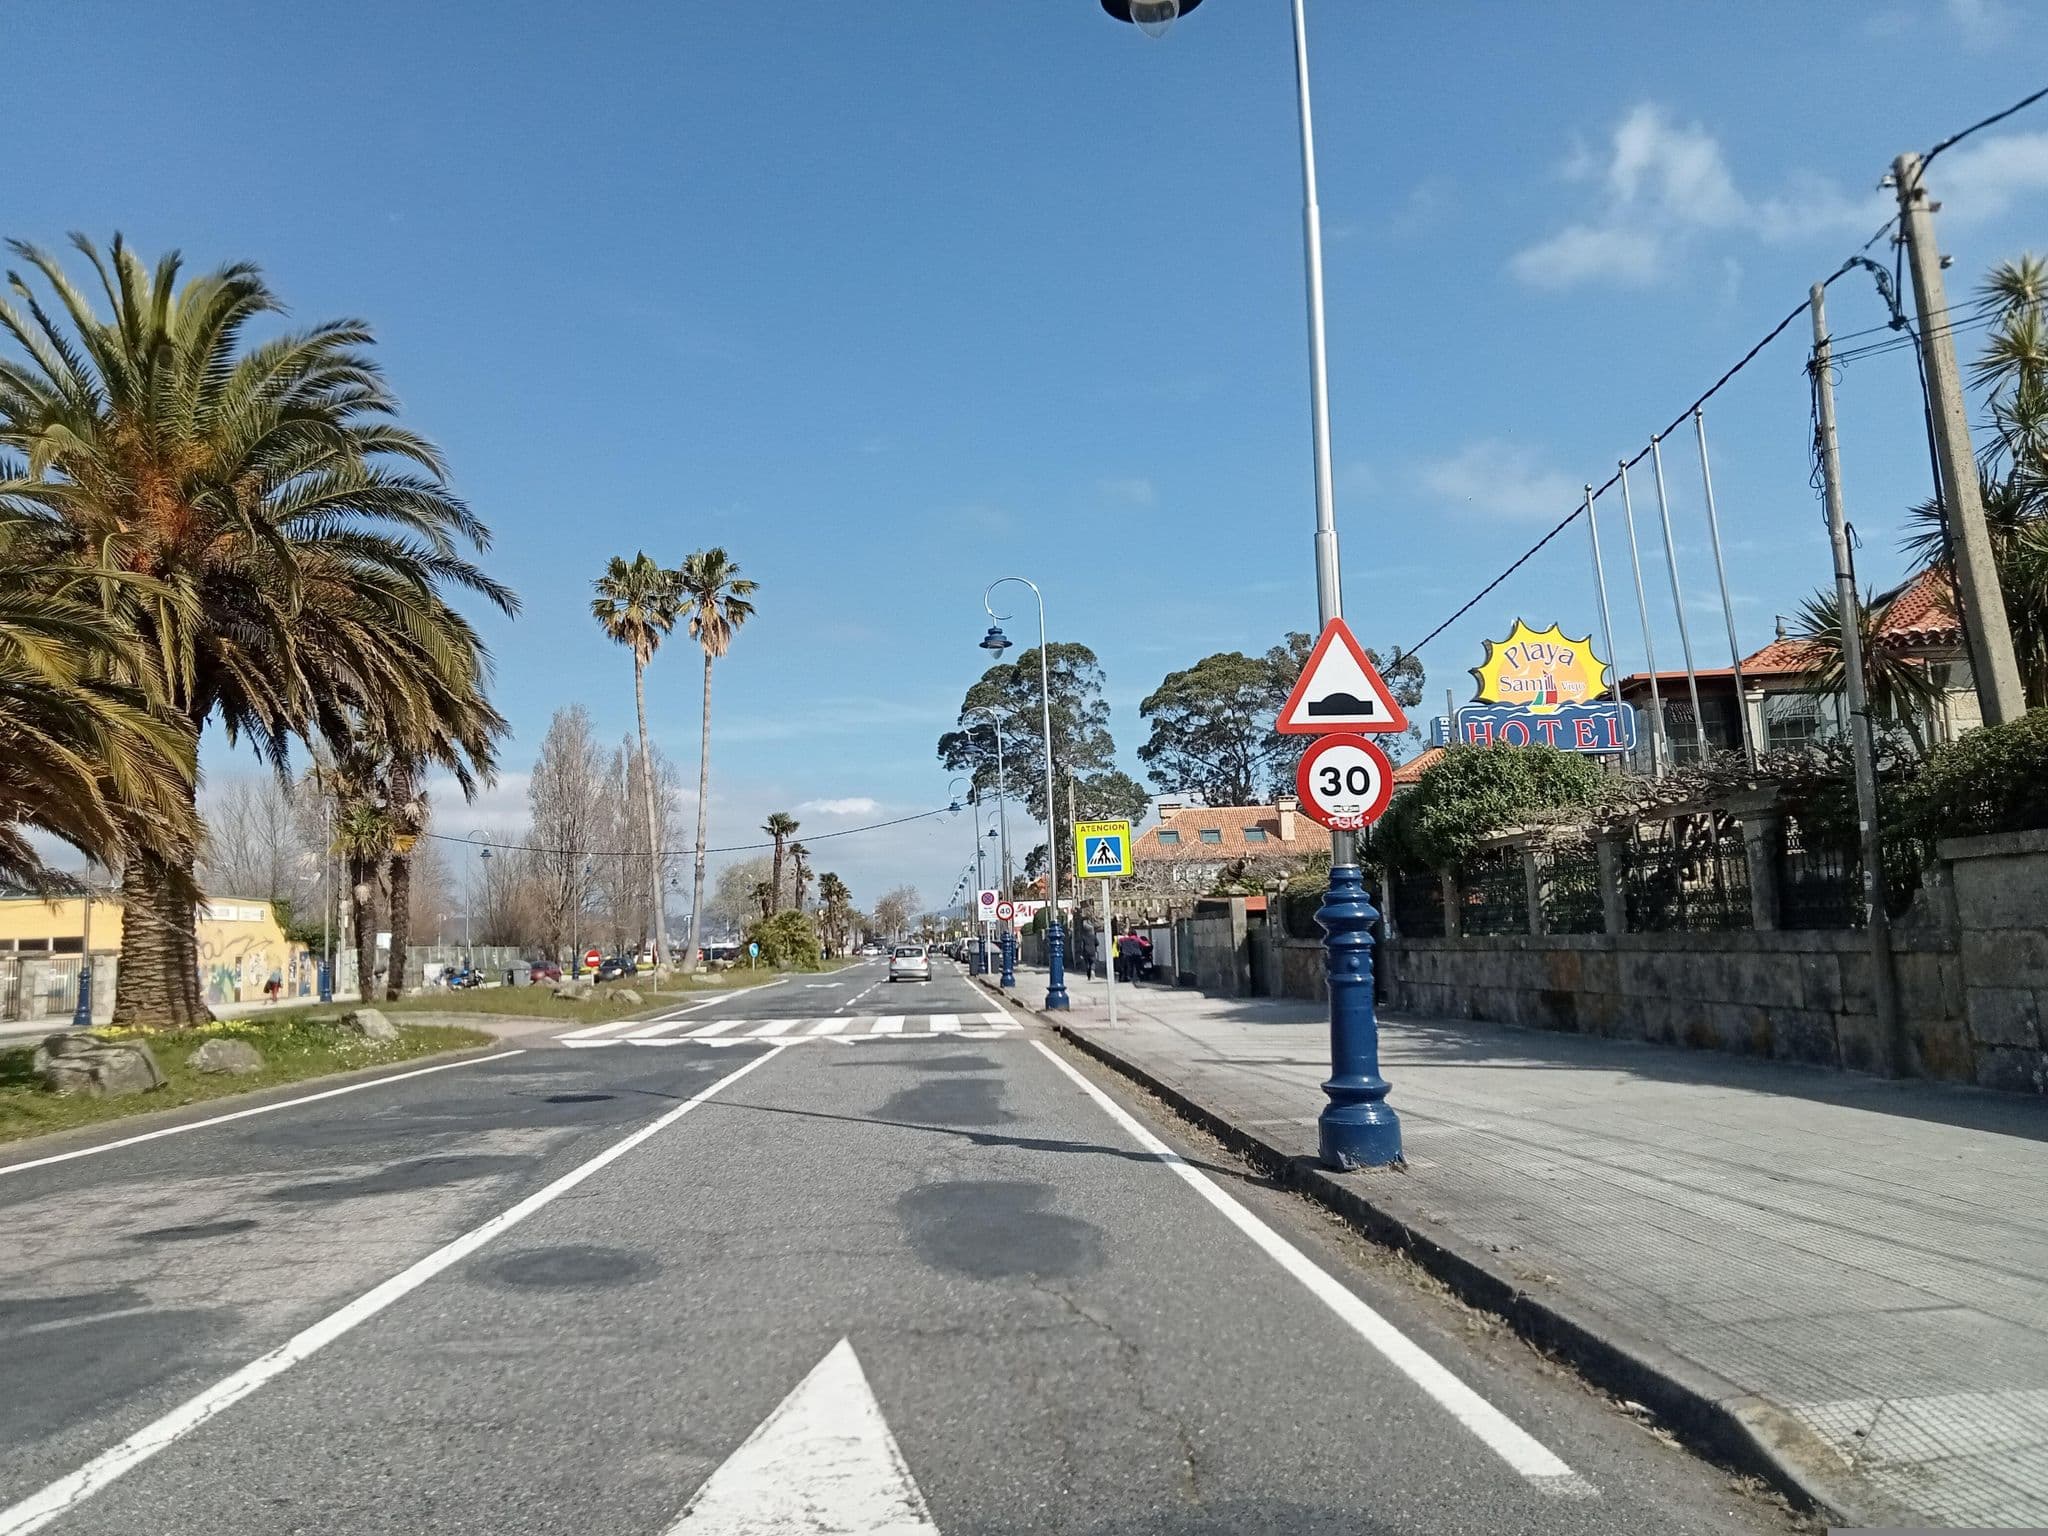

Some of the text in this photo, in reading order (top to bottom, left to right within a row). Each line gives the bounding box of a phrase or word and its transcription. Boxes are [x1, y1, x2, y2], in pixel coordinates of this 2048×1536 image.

[1504, 641, 1574, 668] Playa
[1500, 673, 1554, 692] Samil
[1466, 717, 1629, 748] HOTEL
[1319, 766, 1370, 796] 30
[1080, 823, 1125, 833] ATENCION
